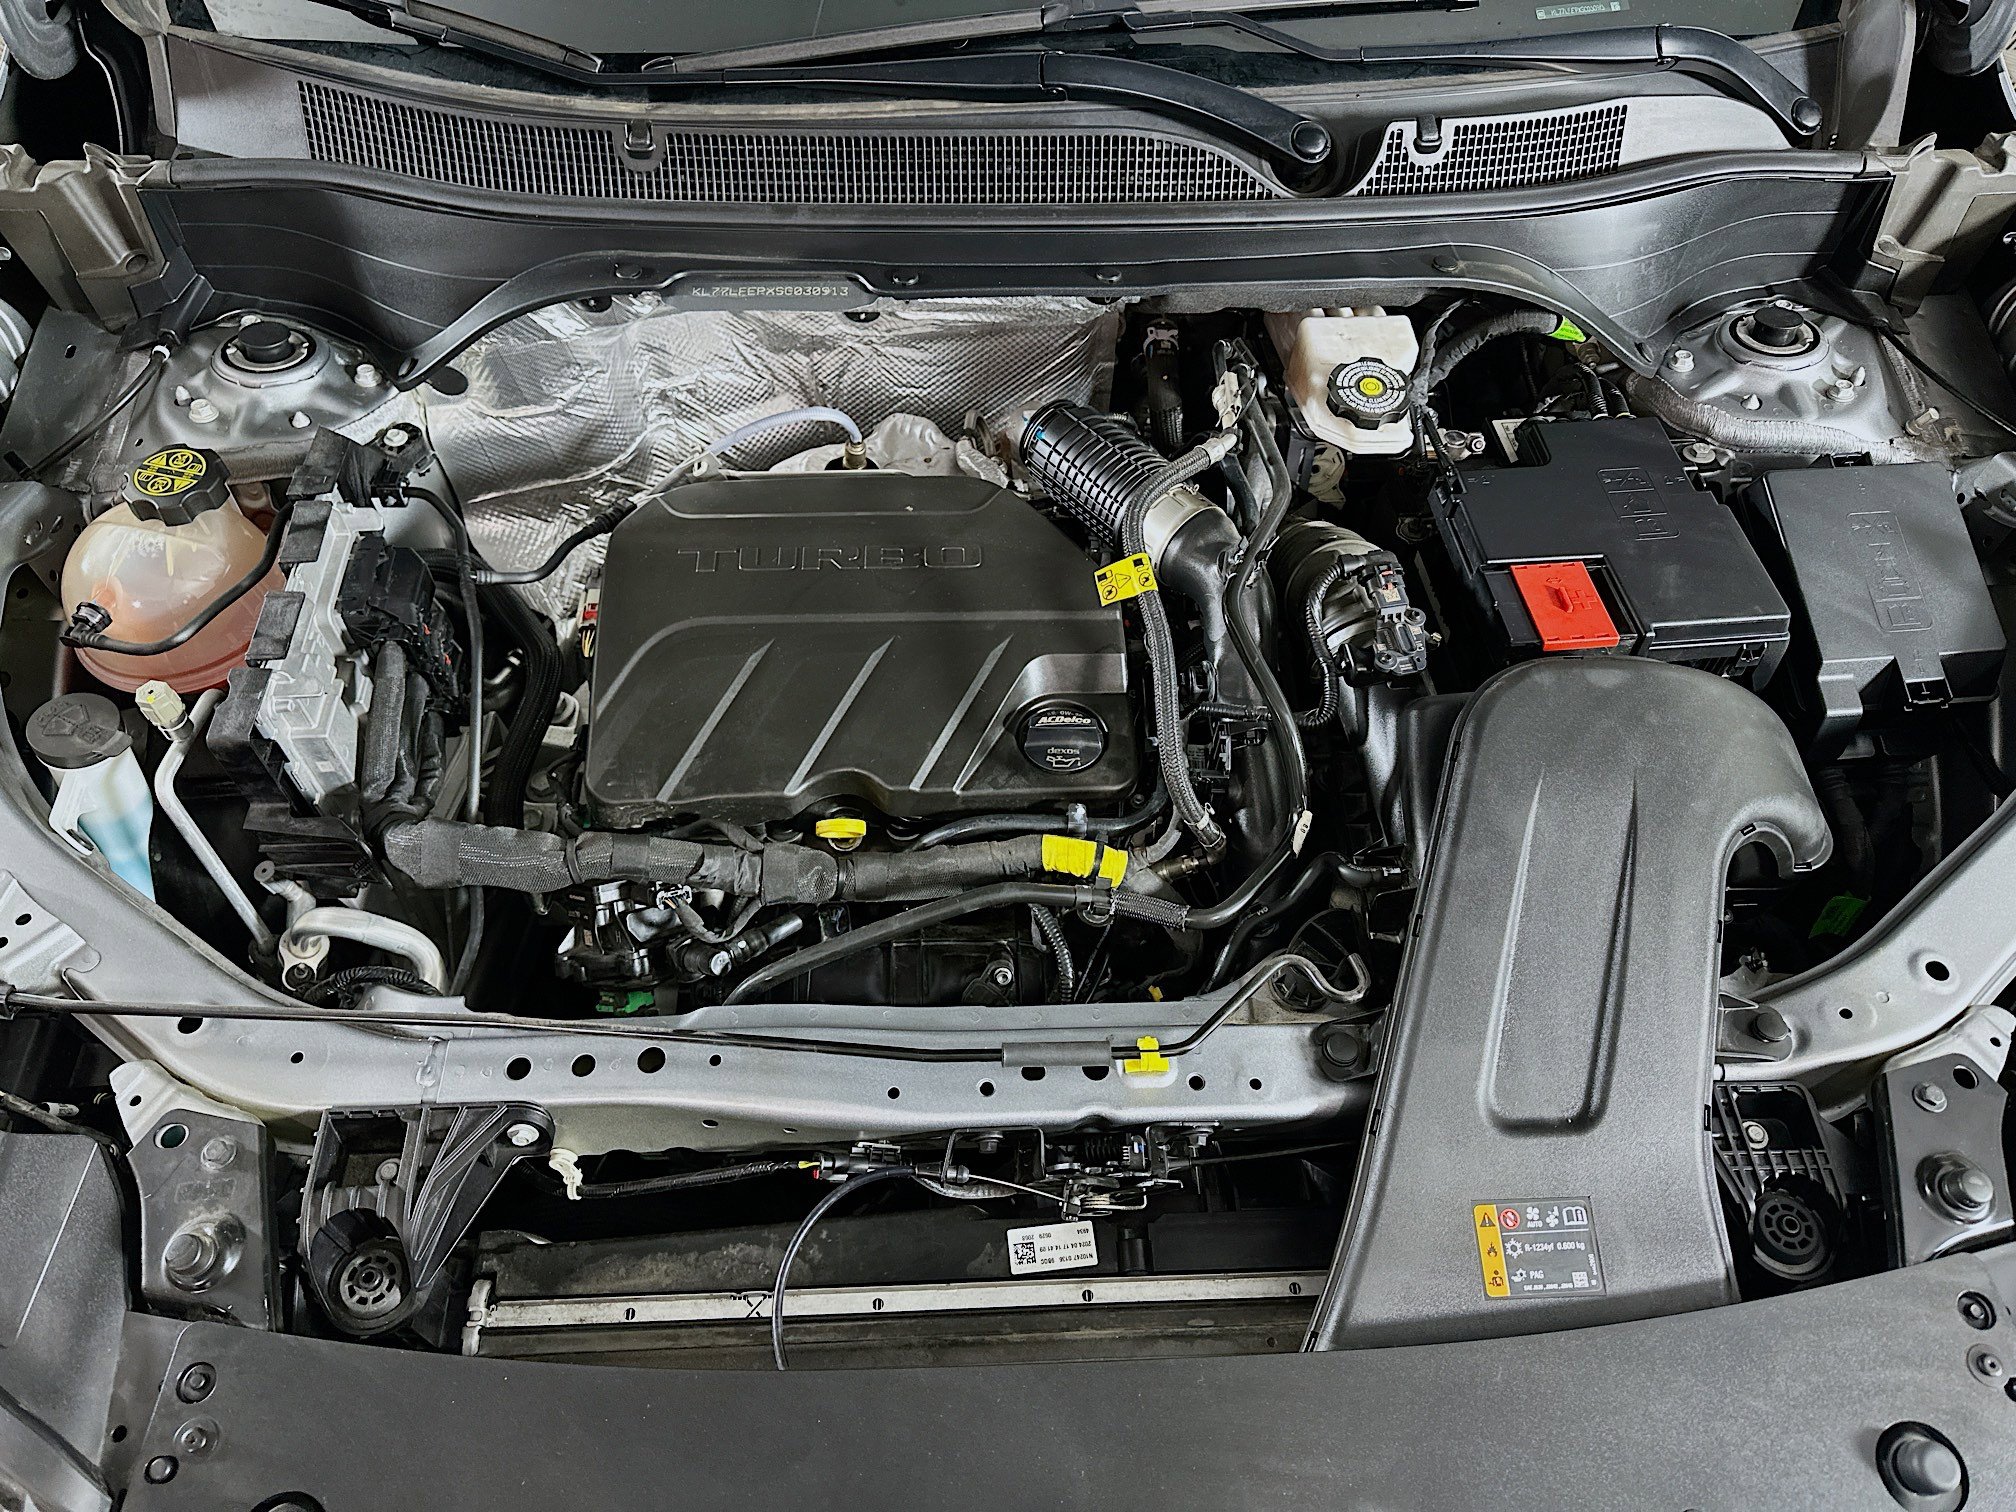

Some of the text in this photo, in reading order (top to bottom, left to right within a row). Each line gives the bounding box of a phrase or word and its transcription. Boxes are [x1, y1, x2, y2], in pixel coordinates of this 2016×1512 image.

[677, 545, 982, 572] TURBO
[1037, 716, 1091, 724] ACDelco
[1047, 747, 1080, 755] dexos
[1527, 1220, 1543, 1228] AUTO
[1557, 1241, 1576, 1250] 0.600
[1576, 1241, 1586, 1251] kg
[1529, 1270, 1544, 1279] PAG
